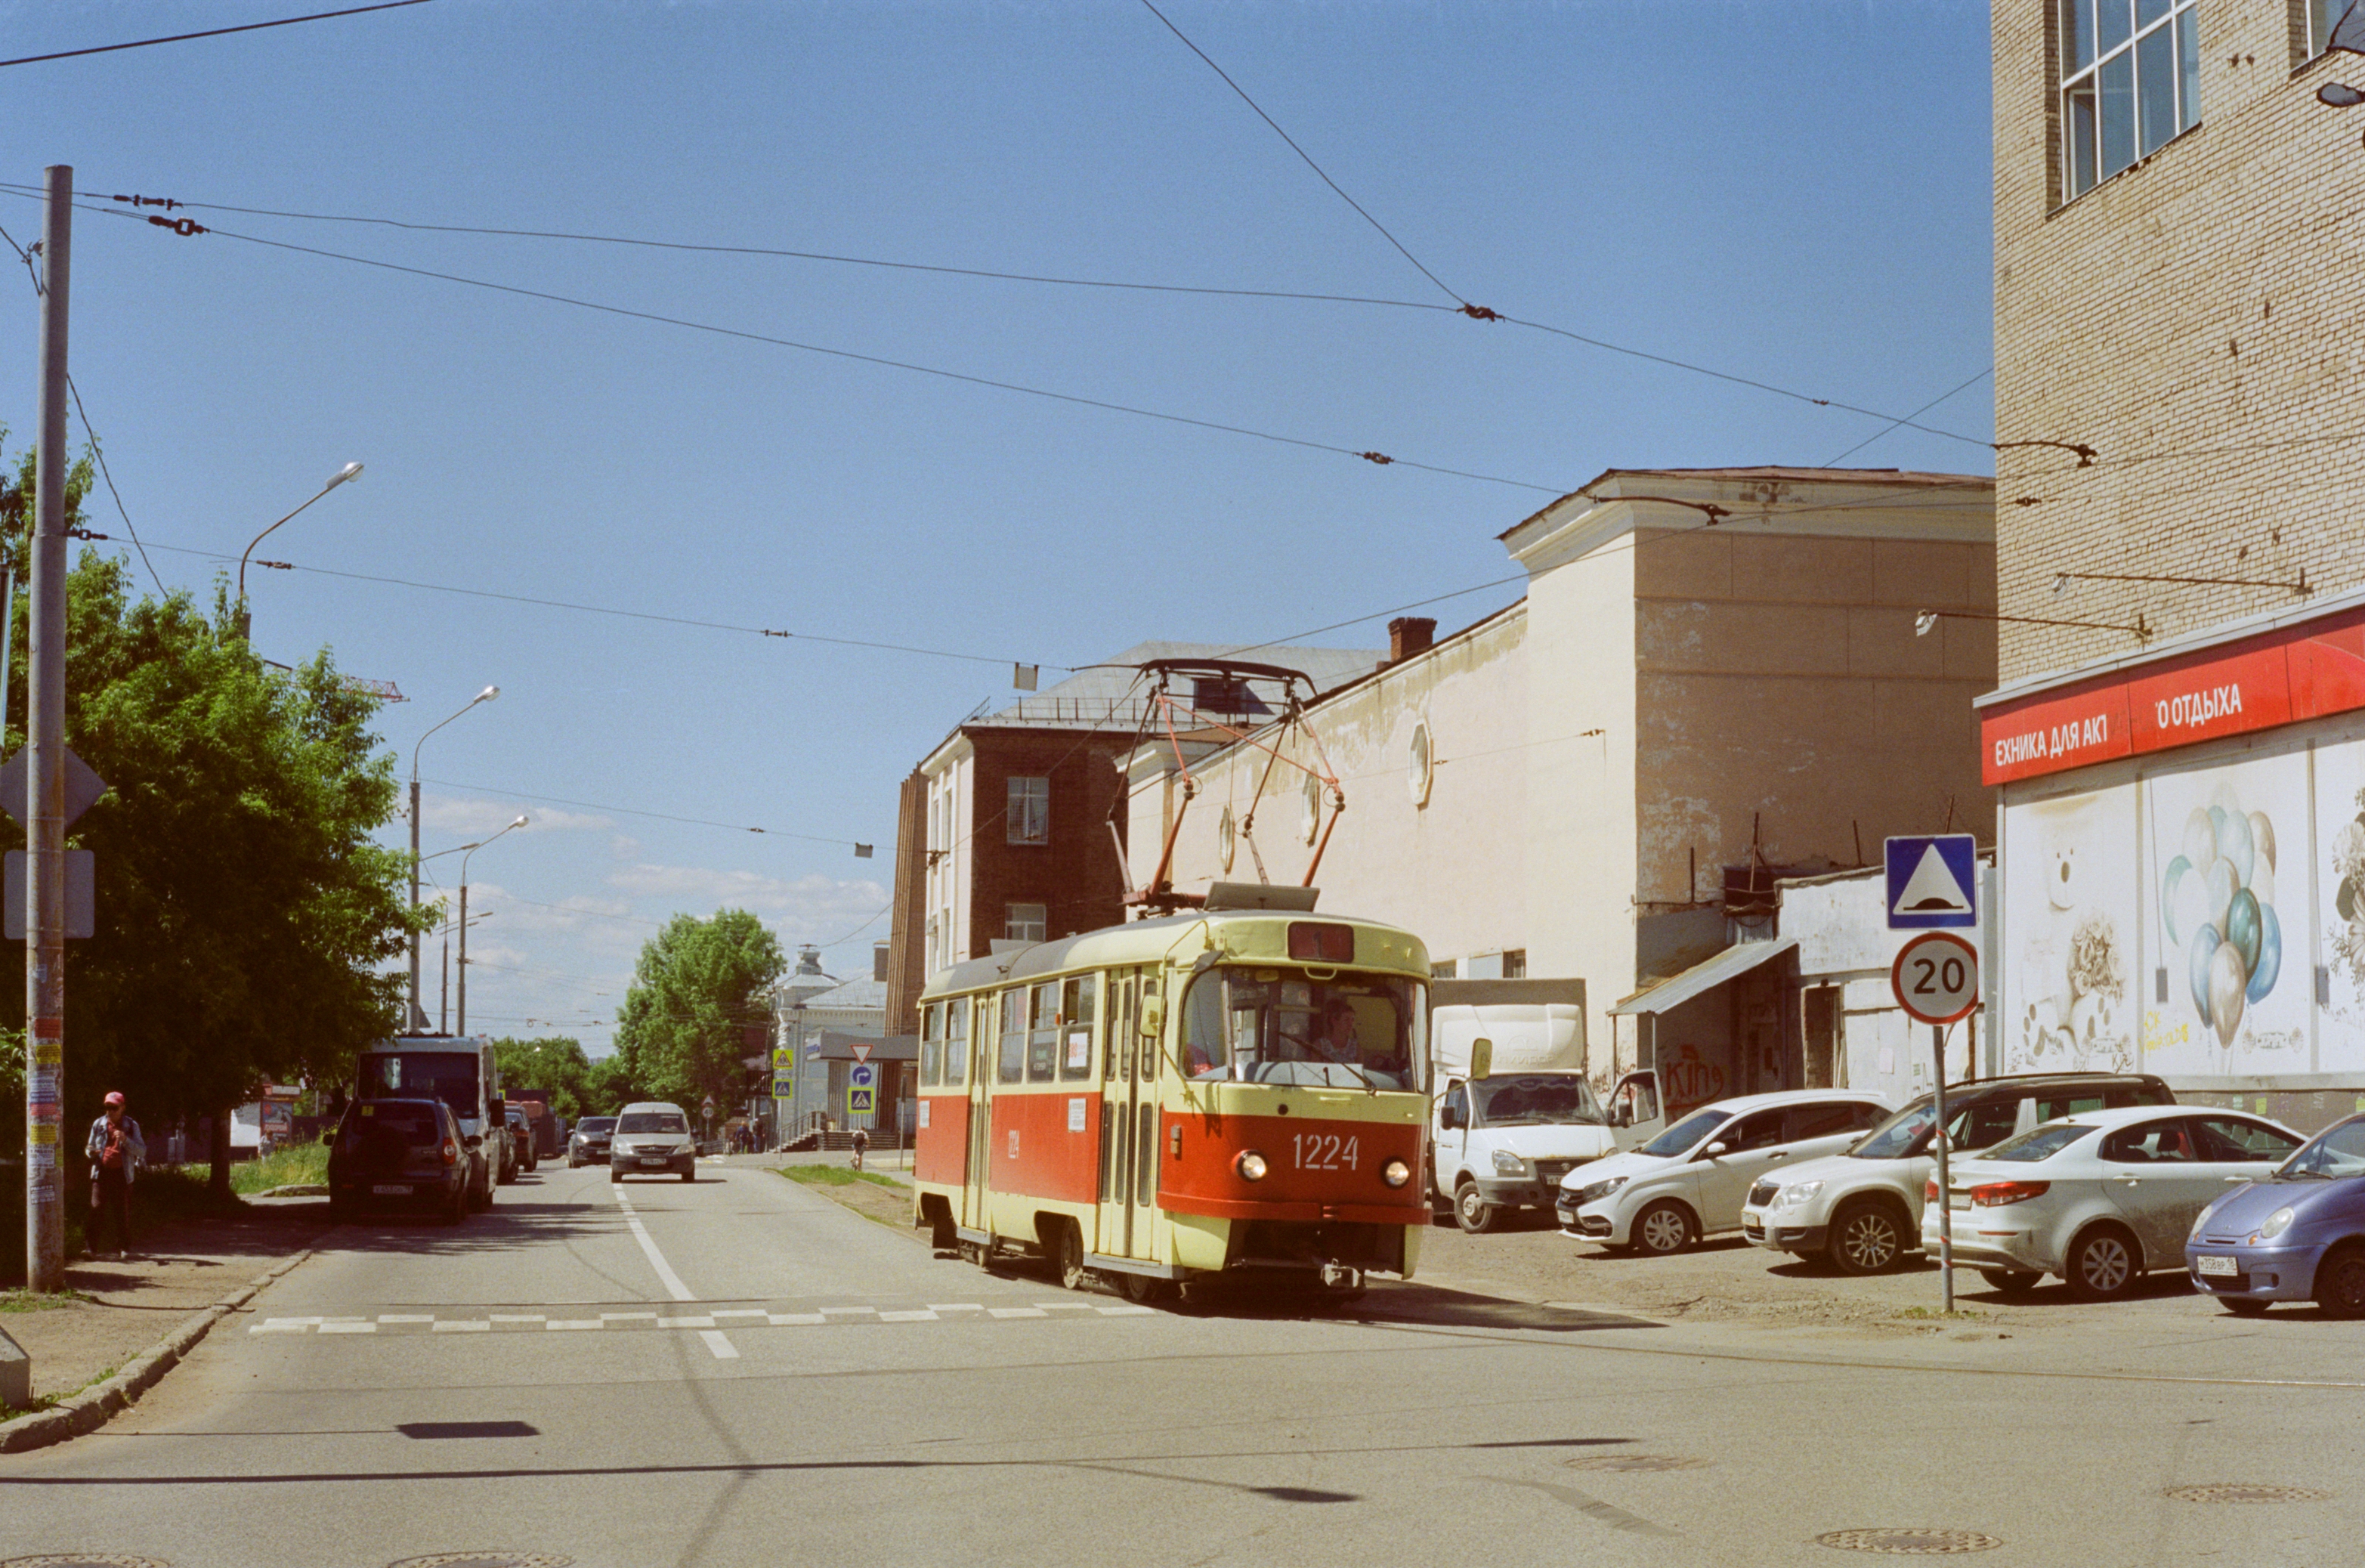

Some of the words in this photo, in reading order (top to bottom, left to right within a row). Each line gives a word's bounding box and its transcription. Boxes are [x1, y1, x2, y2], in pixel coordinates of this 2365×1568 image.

[2050, 722, 2079, 759] ДЛЯ
[2172, 683, 2242, 728] ОТДЫХА
[1913, 957, 1965, 994] 20
[1009, 1130, 1019, 1158] 1224
[1293, 1133, 1359, 1171] 1224
